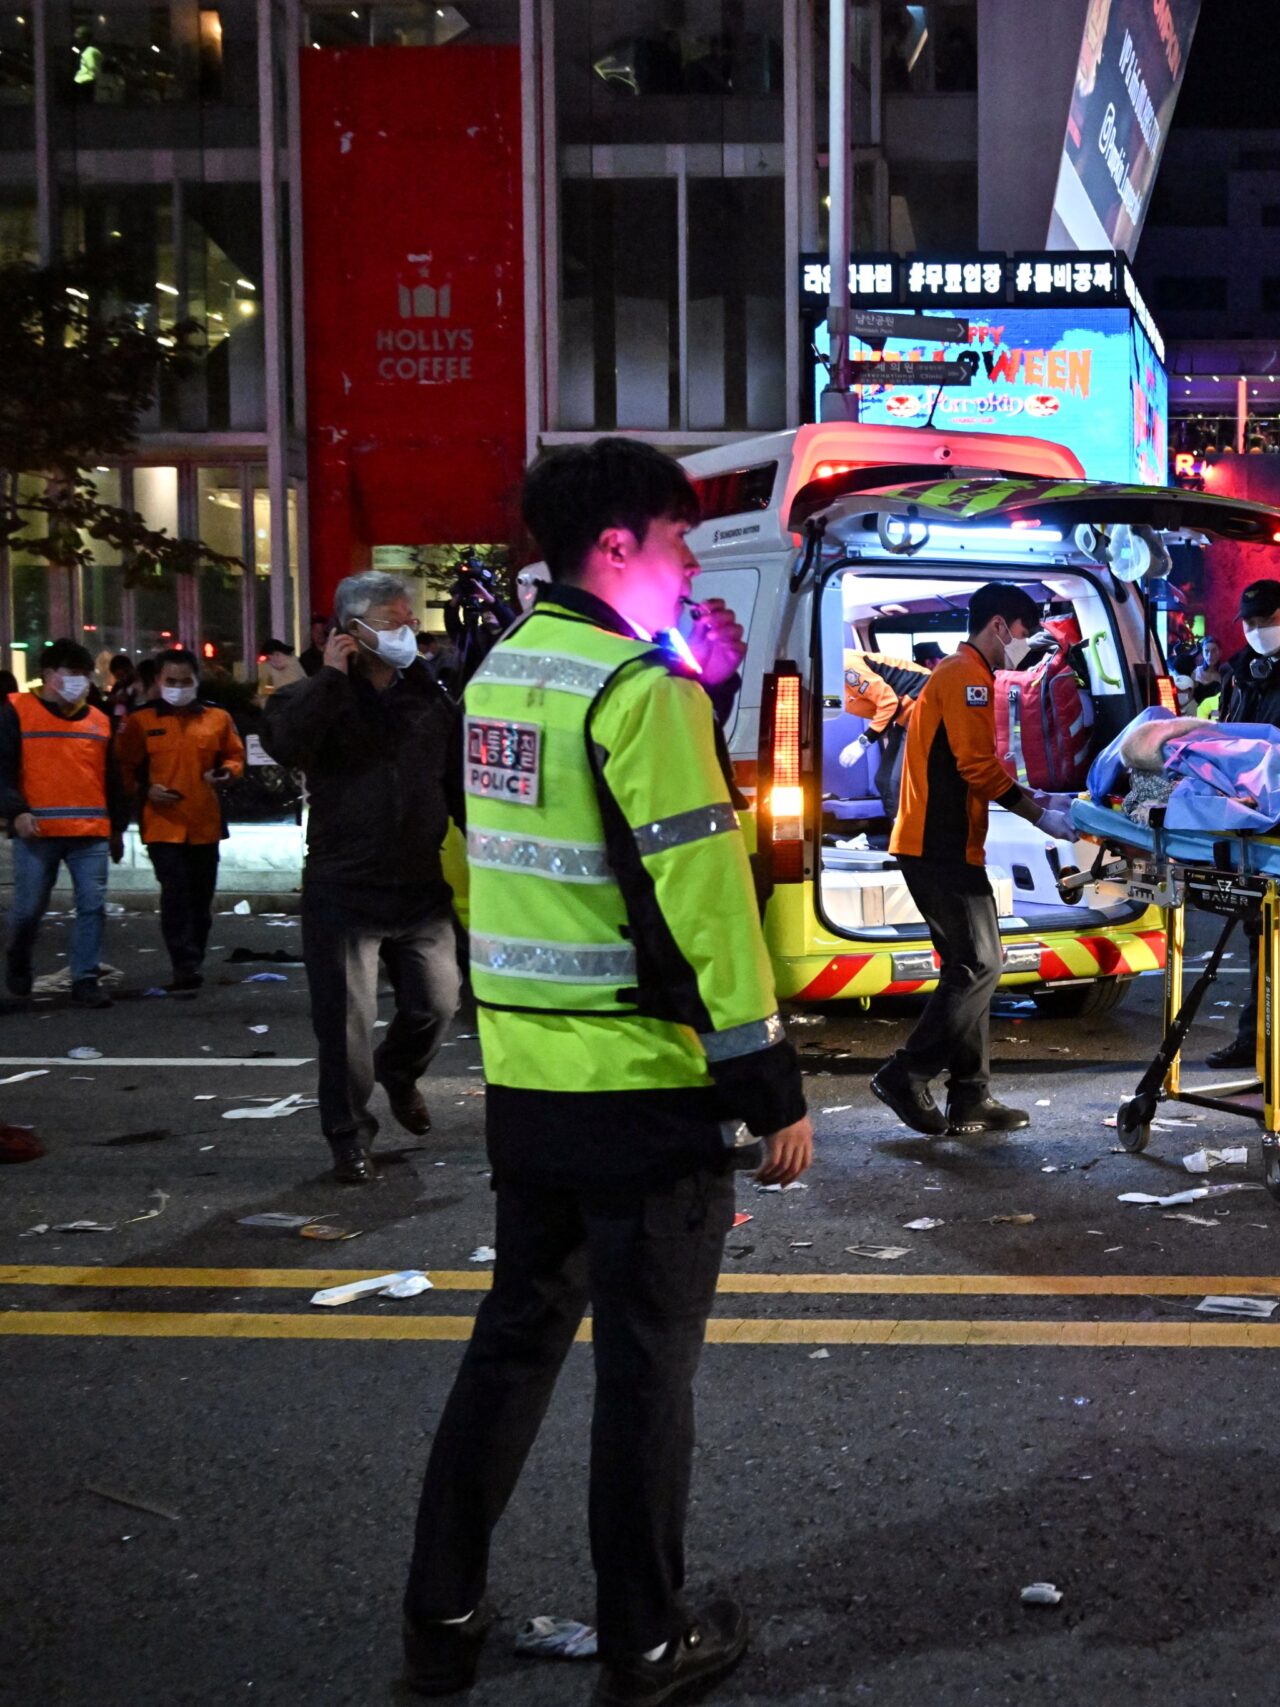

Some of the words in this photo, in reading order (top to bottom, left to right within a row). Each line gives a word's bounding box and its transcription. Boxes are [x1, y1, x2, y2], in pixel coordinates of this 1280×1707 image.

[376, 328, 474, 351] HOLLYS
[378, 357, 473, 379] COFFEE
[470, 769, 531, 796] POLICE
